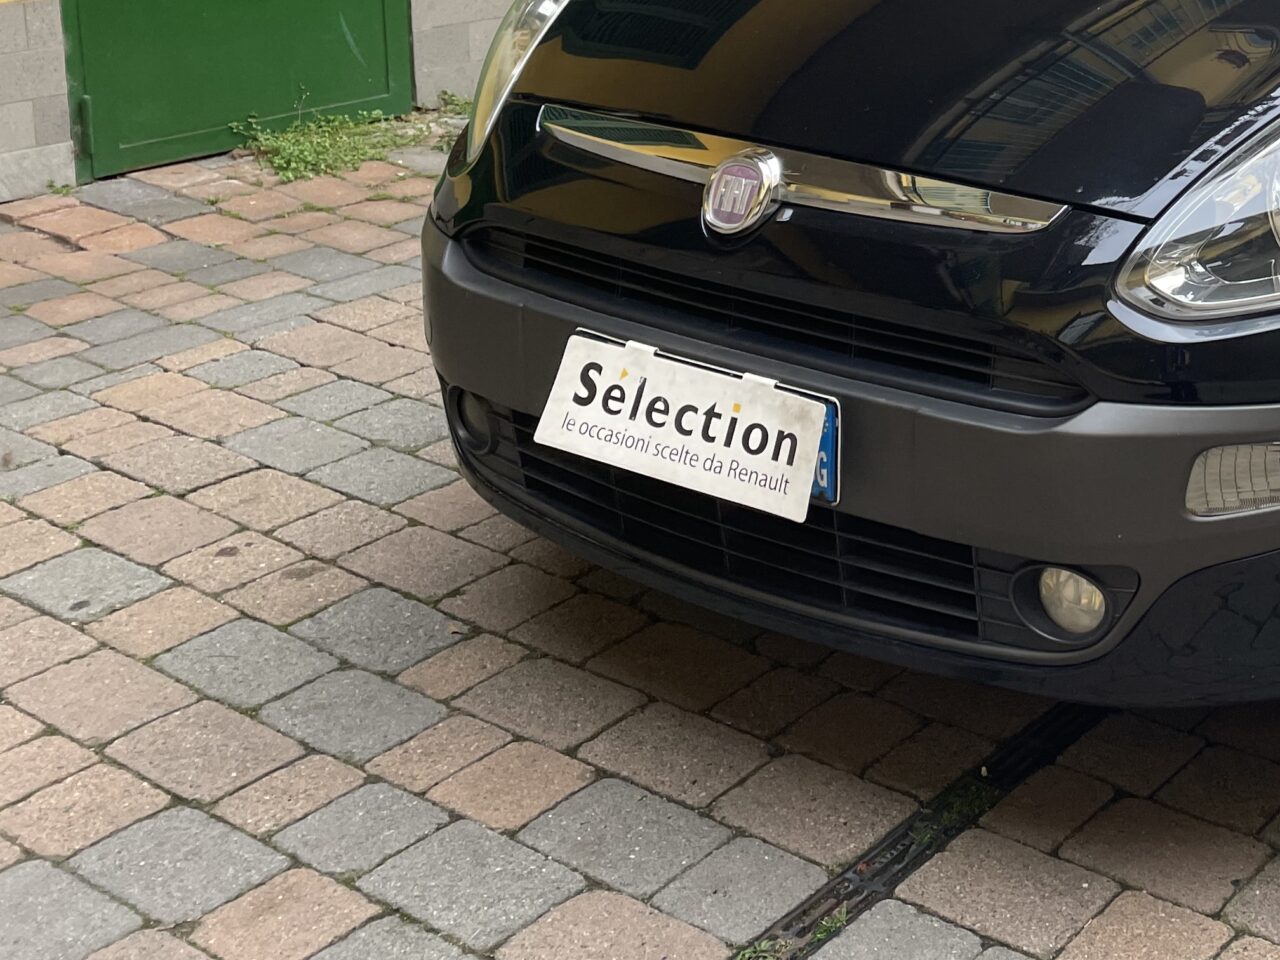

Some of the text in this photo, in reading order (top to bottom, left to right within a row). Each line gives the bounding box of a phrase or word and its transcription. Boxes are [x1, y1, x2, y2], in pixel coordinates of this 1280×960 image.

[561, 411, 790, 495] le occasioni scelte da Renault
[571, 361, 799, 467] Sélection
